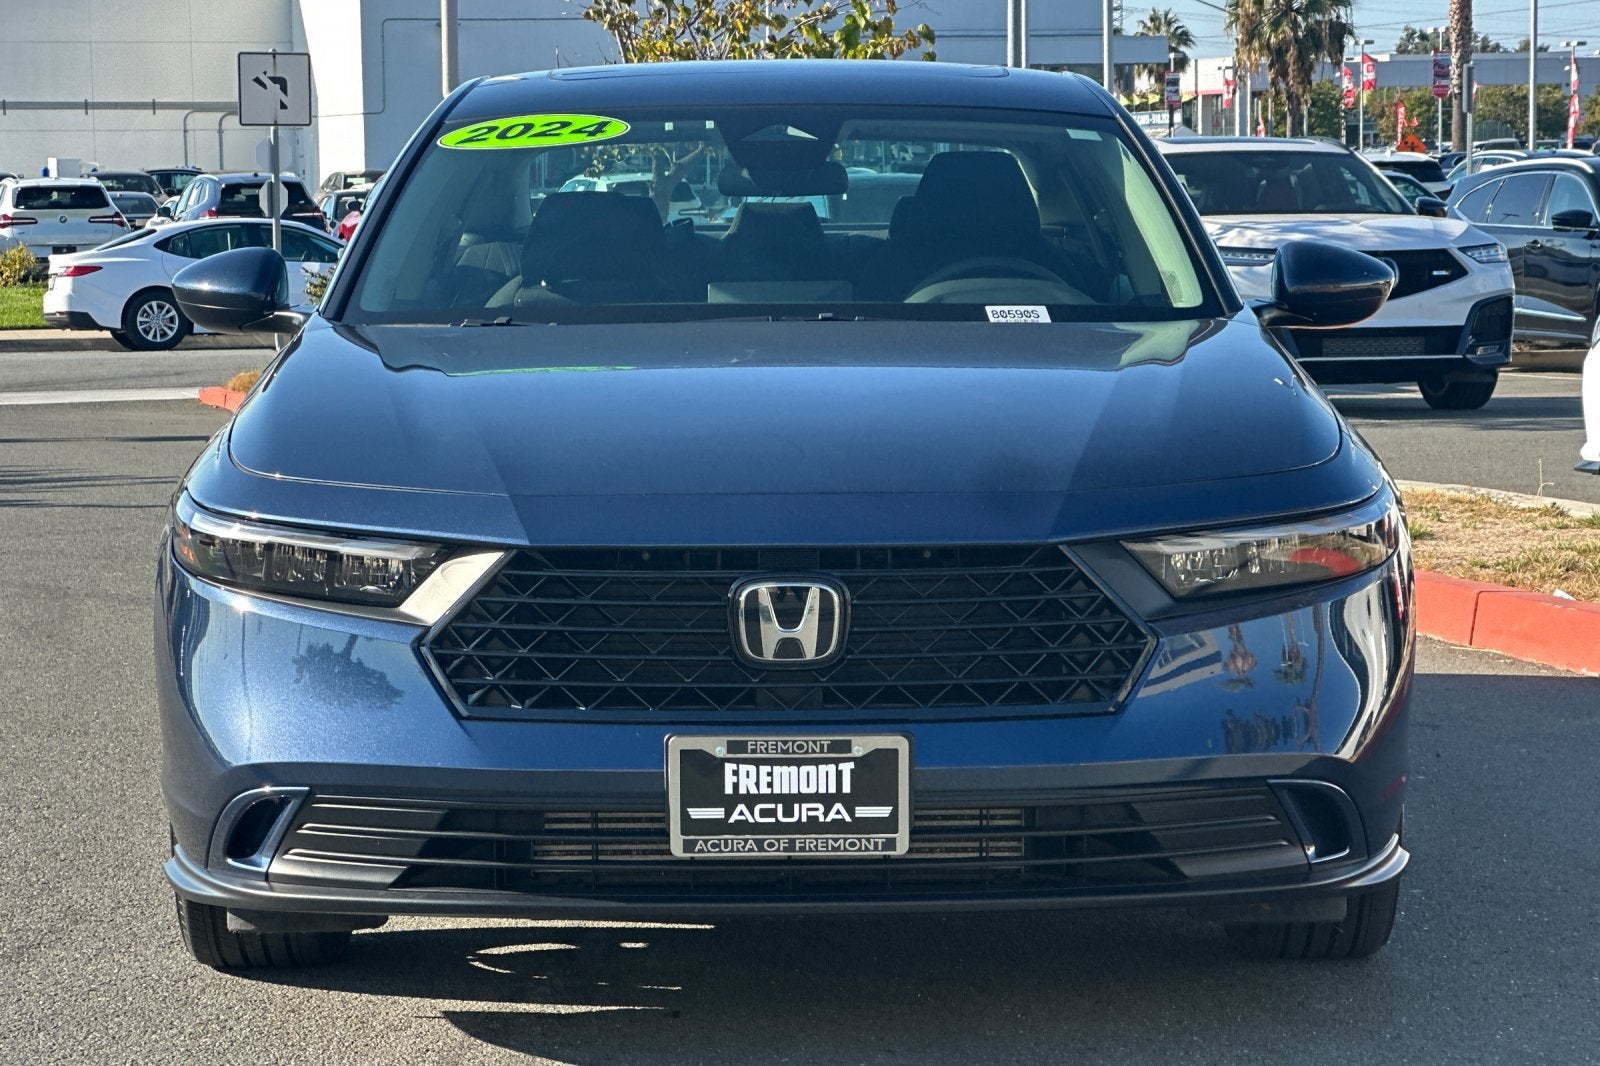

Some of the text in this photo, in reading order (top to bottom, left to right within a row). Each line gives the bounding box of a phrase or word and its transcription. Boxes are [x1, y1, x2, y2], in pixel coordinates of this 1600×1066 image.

[454, 120, 612, 145] 2024
[747, 740, 831, 754] FREMONT
[724, 761, 855, 795] FREMONT
[728, 802, 852, 823] ACURA
[694, 838, 886, 853] ACURA OF FREMONT
